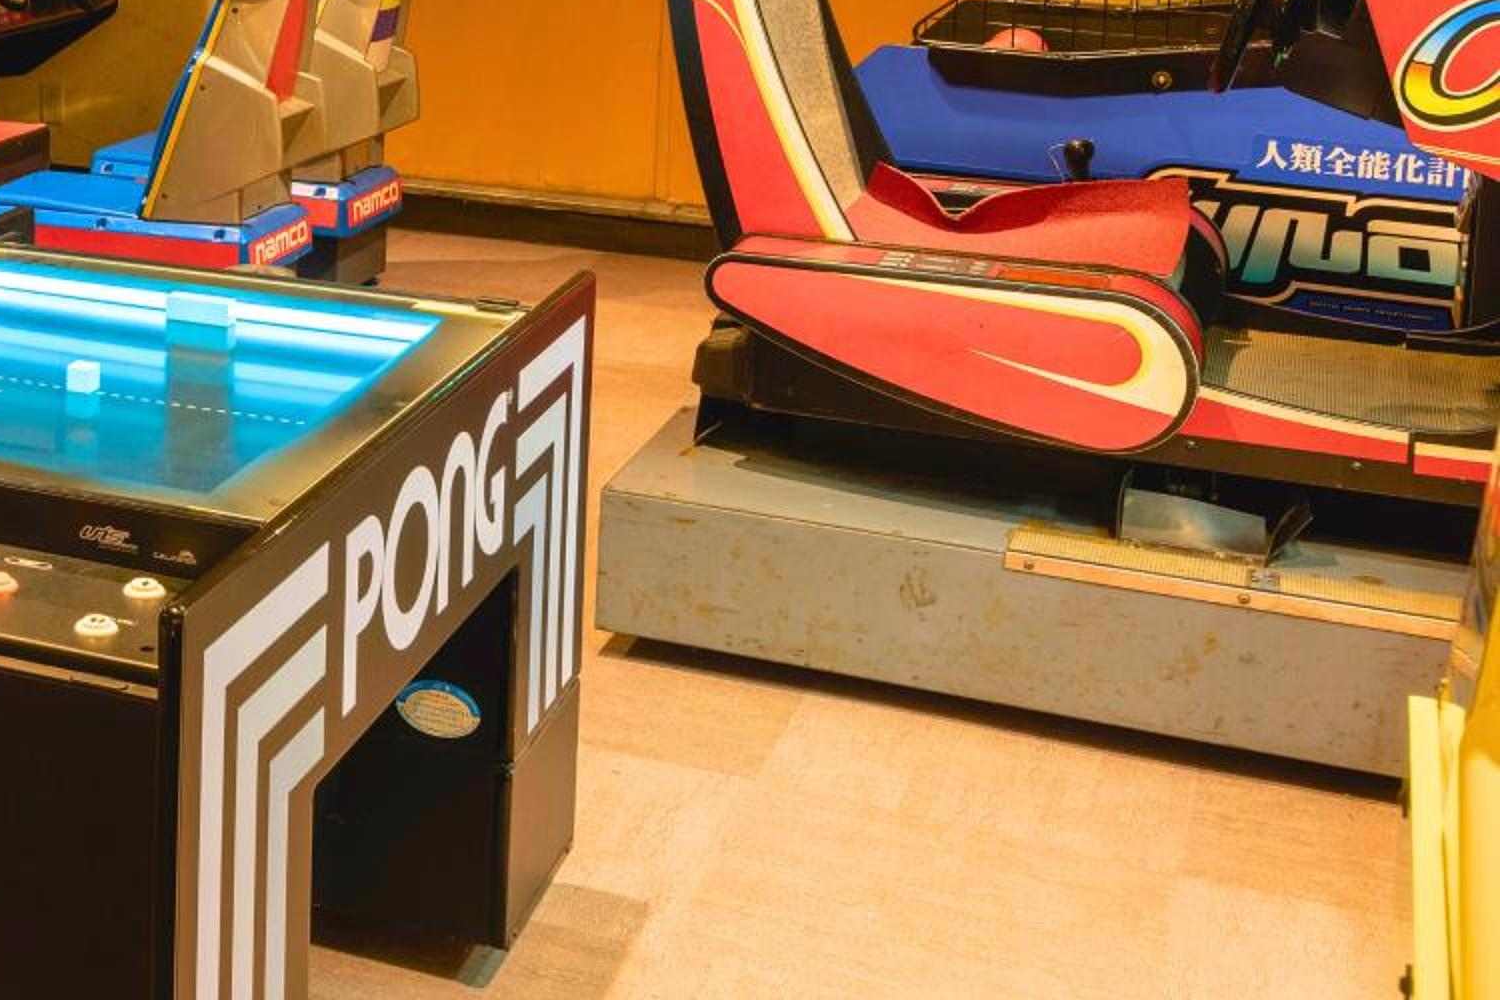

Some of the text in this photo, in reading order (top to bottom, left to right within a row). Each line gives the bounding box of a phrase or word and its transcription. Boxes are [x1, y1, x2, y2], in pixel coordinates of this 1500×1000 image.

[1255, 138, 1470, 189] 人類全能化計
[353, 182, 399, 222] namco
[255, 220, 308, 265] namco
[342, 390, 506, 718] PONG
